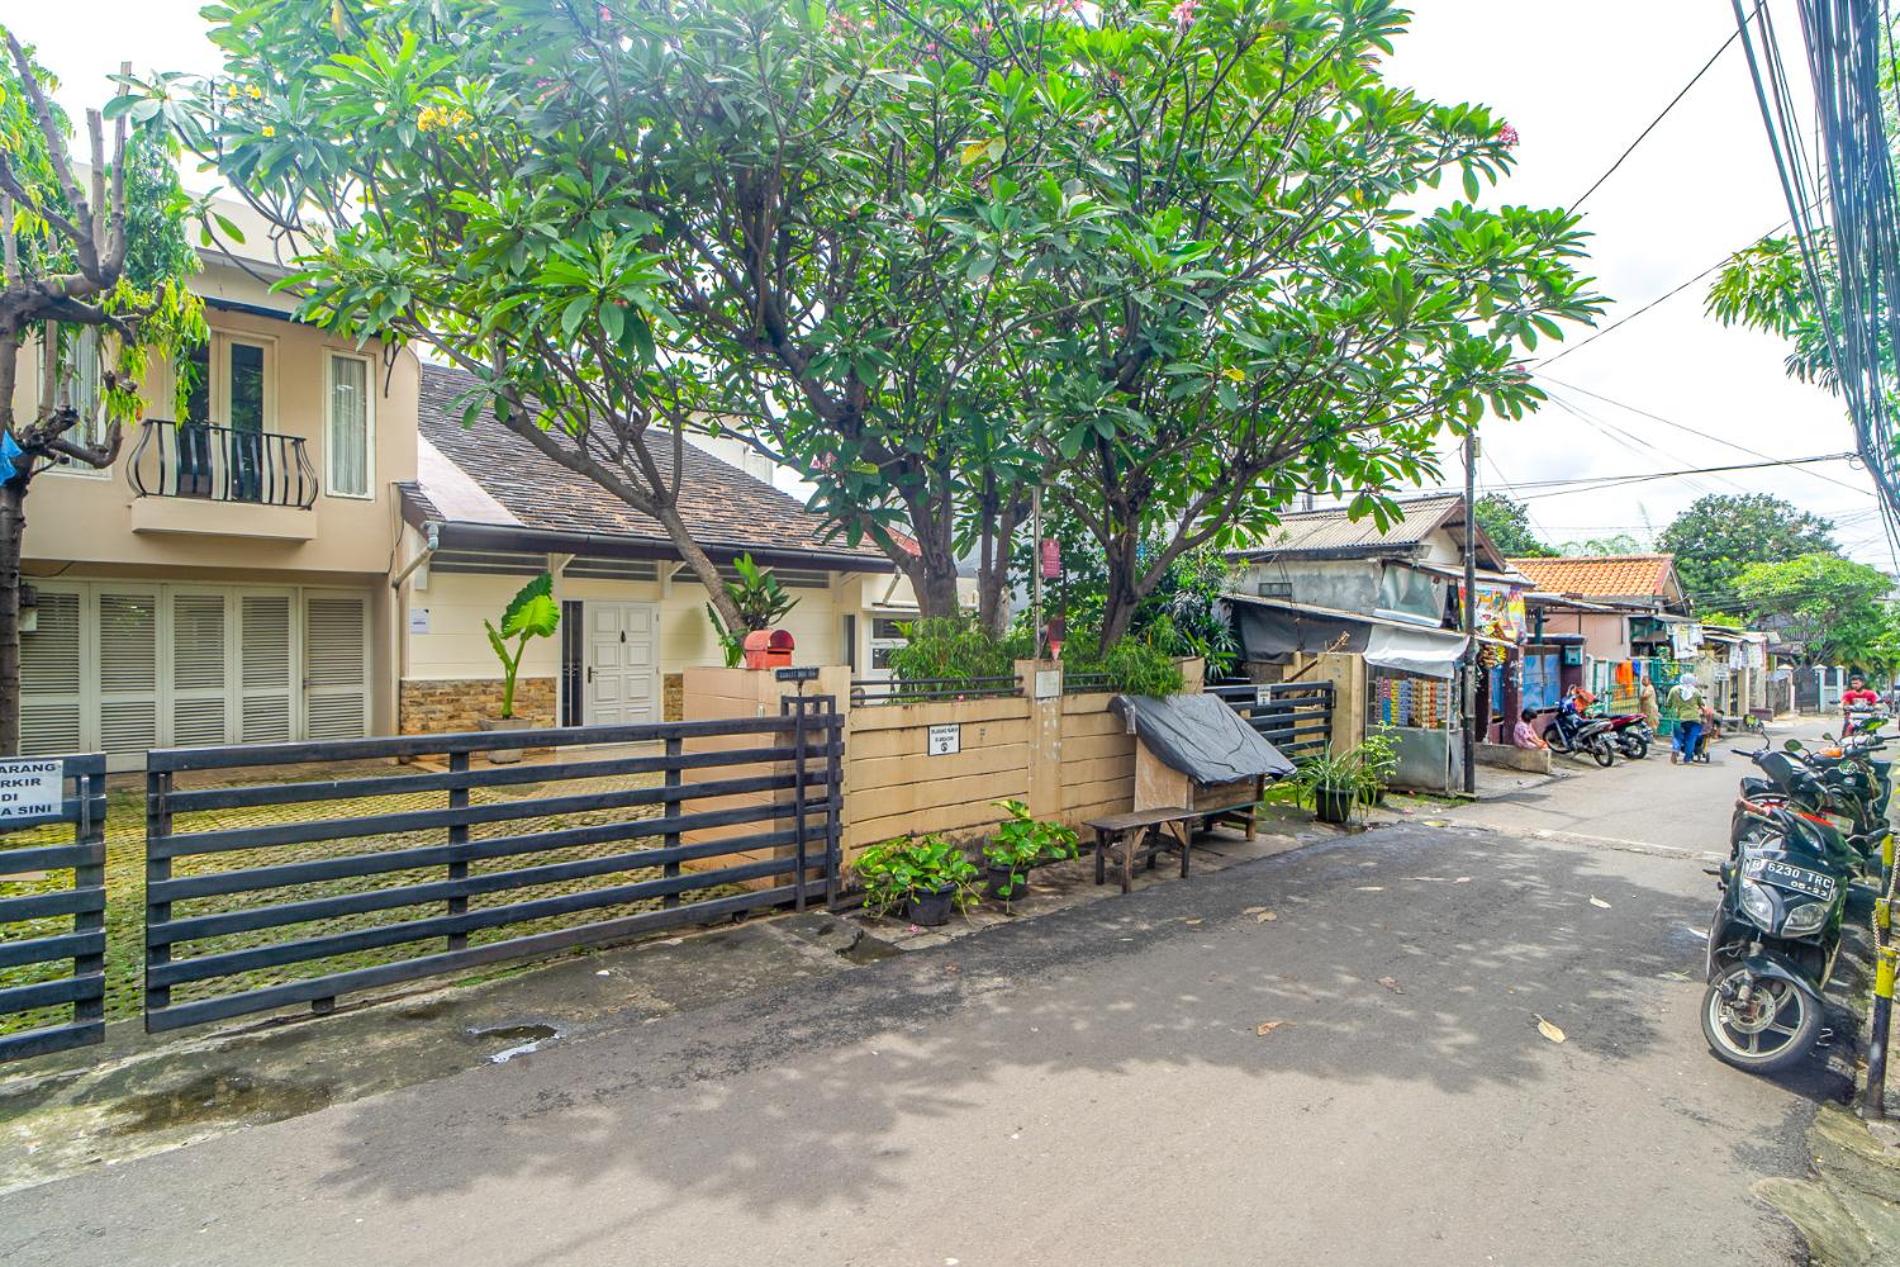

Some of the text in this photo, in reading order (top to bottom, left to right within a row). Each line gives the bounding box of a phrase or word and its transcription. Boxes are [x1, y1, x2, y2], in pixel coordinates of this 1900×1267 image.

[1, 778, 41, 788] RKIR
[2, 793, 18, 802] DI
[1, 804, 52, 816] A SINI
[1767, 863, 1800, 878] 6230
[1807, 872, 1831, 888] TRC
